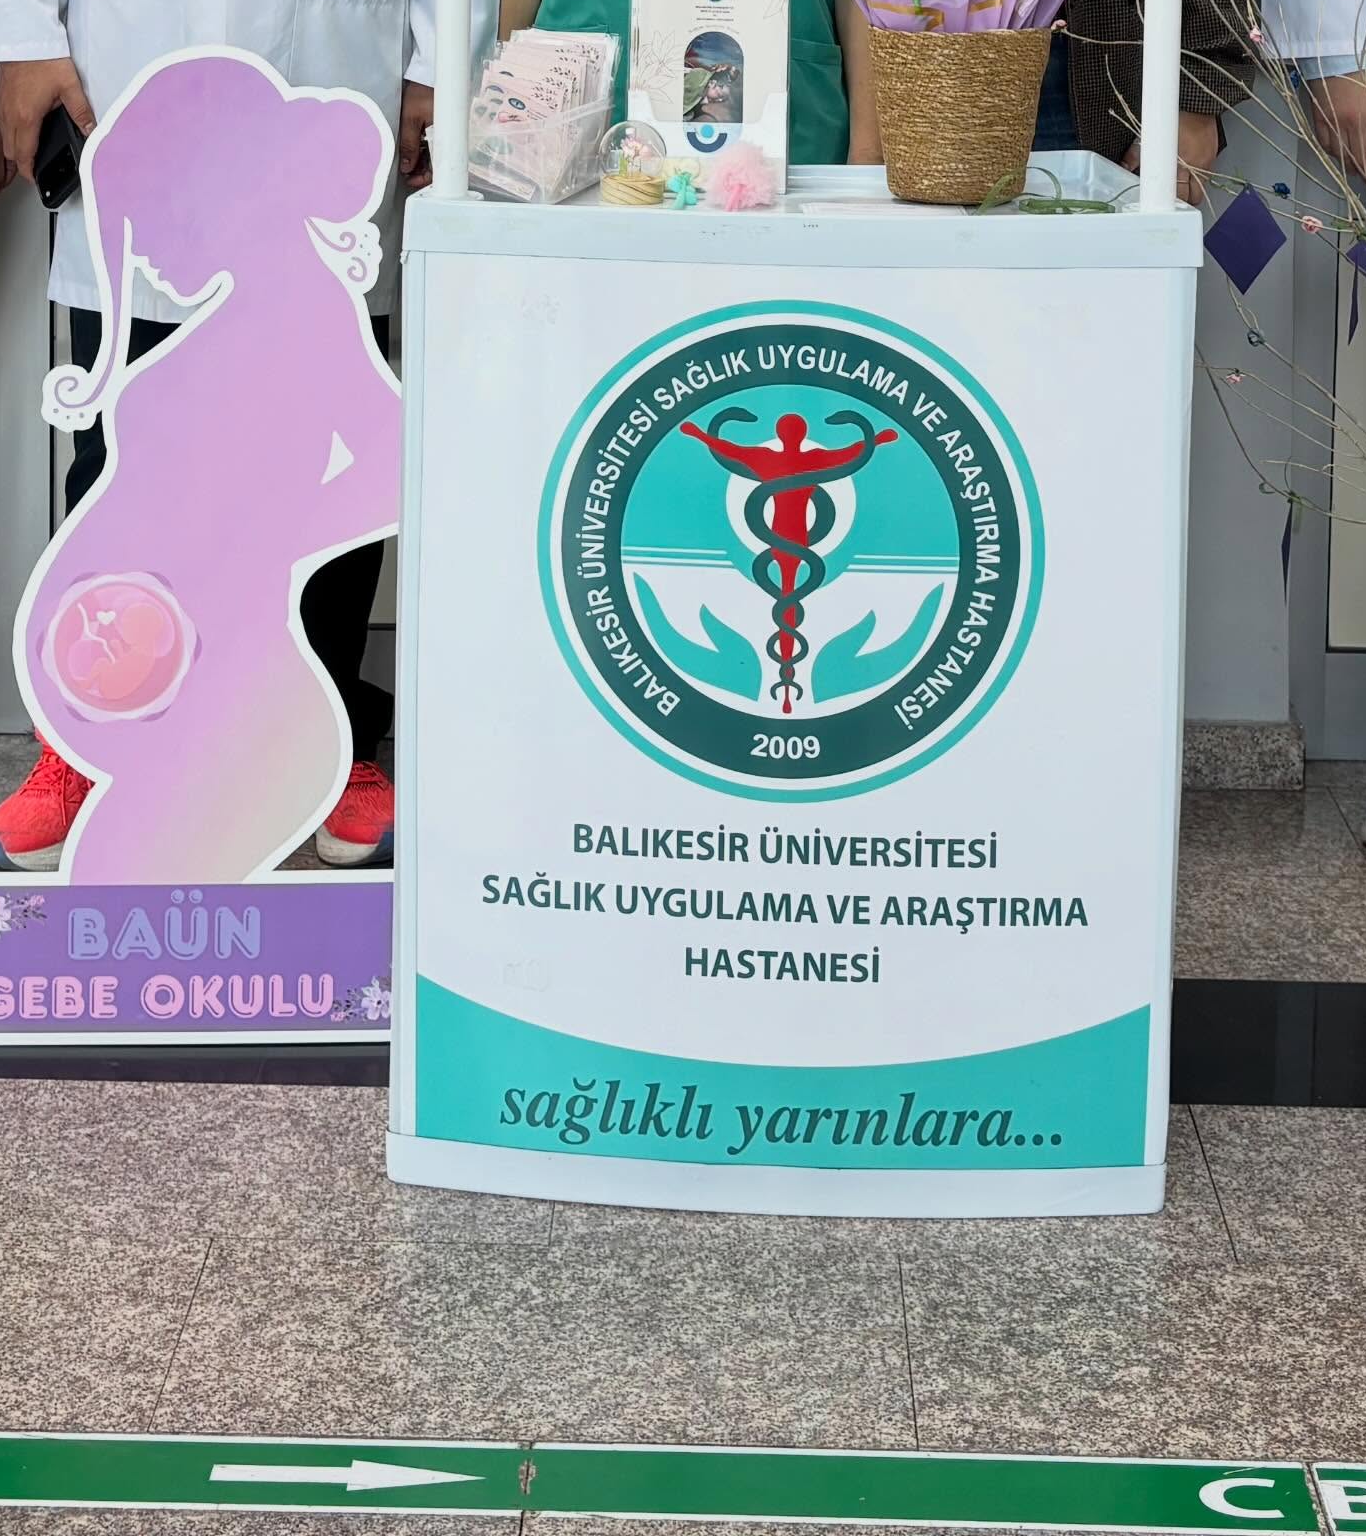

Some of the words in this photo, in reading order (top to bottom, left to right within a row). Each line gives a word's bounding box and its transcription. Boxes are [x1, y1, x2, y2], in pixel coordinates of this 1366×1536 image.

[653, 349, 752, 412] SAĞLIK
[757, 344, 911, 406] UYGULAMA
[911, 392, 948, 430] VE
[575, 395, 662, 582] ÜNİVERSİTESİ
[935, 424, 1002, 585] ARAŞTIRMA
[585, 584, 681, 718] BALIKESİR
[894, 590, 997, 731] HASTANESİ
[749, 733, 821, 760] 2009
[572, 823, 749, 865] BALIKESİR
[759, 825, 999, 870] ÜNİVERSİTESİ
[67, 888, 262, 961] BAÜN
[481, 874, 606, 914] SAĞLIK
[615, 884, 819, 925] UYGULAMA
[827, 895, 872, 926] VE
[880, 895, 1089, 935] ARAŞTIRMA
[140, 973, 335, 1019] OKULU
[684, 946, 881, 984] HASTANESİ
[499, 1076, 714, 1146] sağlıklı
[727, 1091, 1065, 1154] yarınlara...
[1198, 1477, 1285, 1518] C
